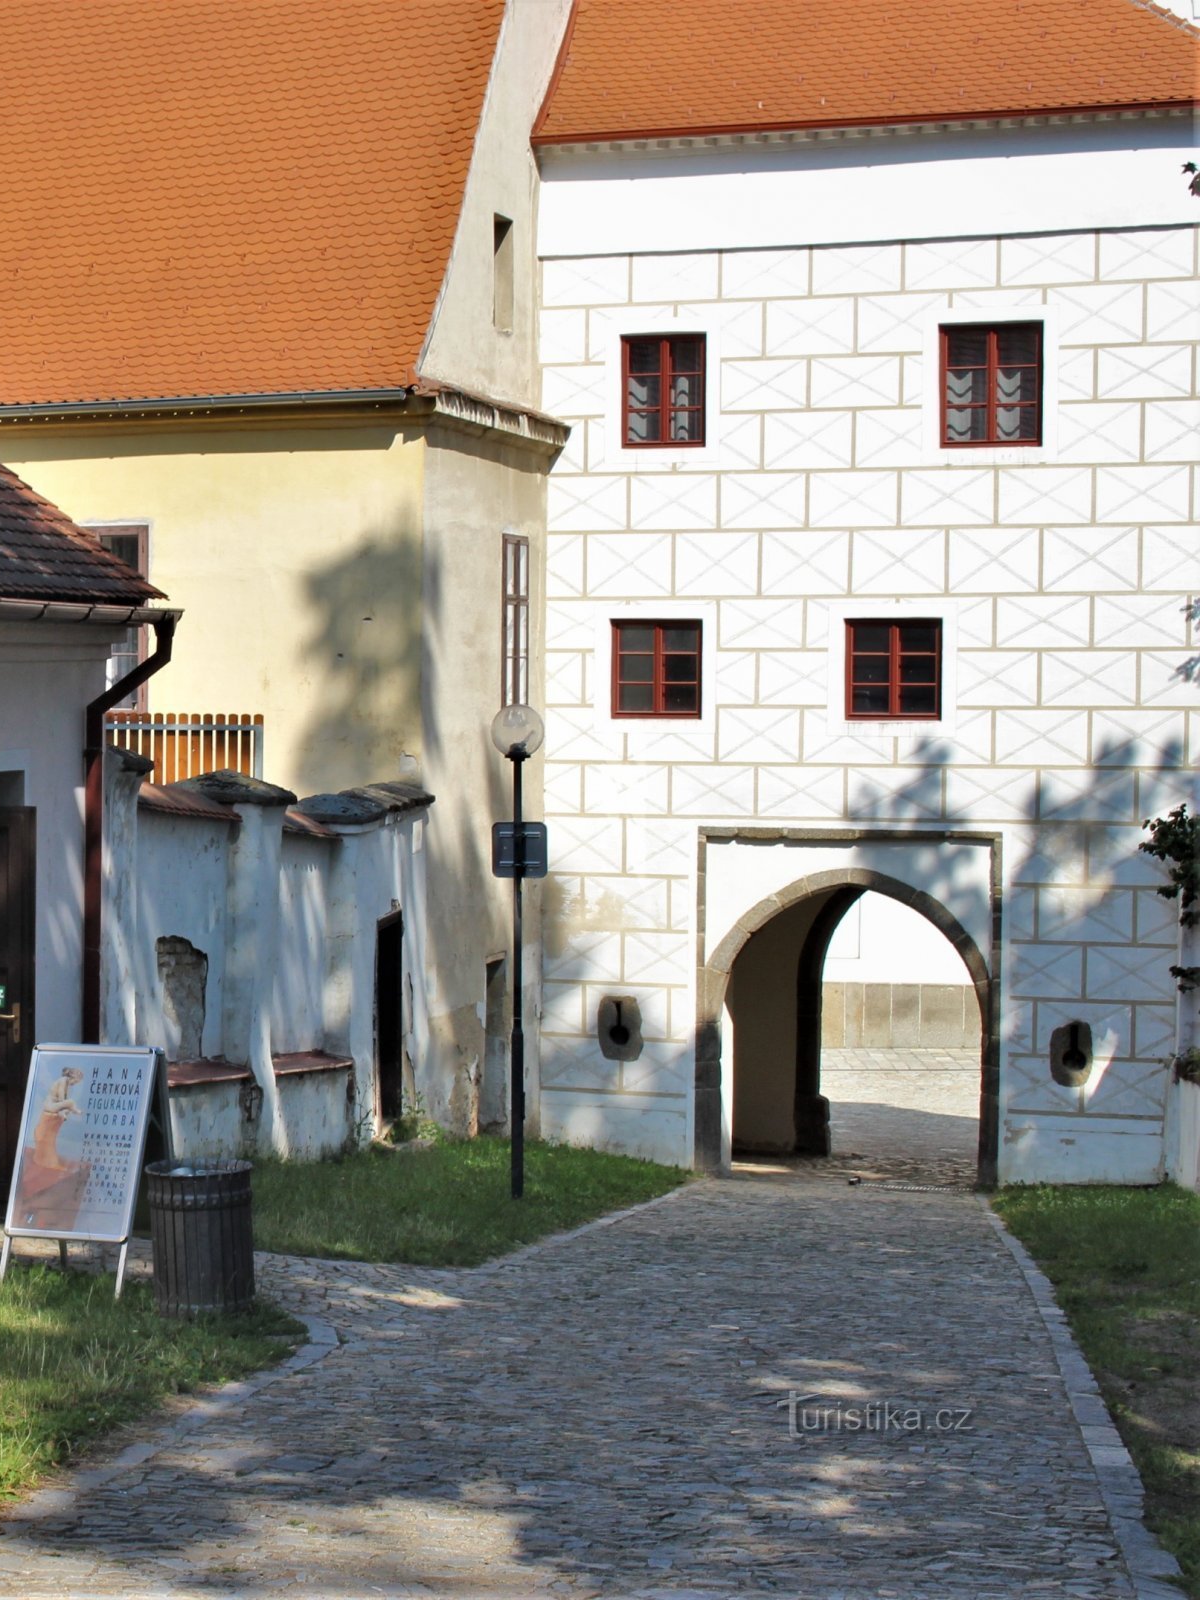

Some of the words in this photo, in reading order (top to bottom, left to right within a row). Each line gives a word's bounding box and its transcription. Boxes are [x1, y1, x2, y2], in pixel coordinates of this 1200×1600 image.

[92, 1067, 142, 1080] HANA
[90, 1080, 140, 1095] ČERTKOVÁ
[87, 1096, 139, 1111] FIGURÁLNÍ
[85, 1113, 135, 1126] TVORBA
